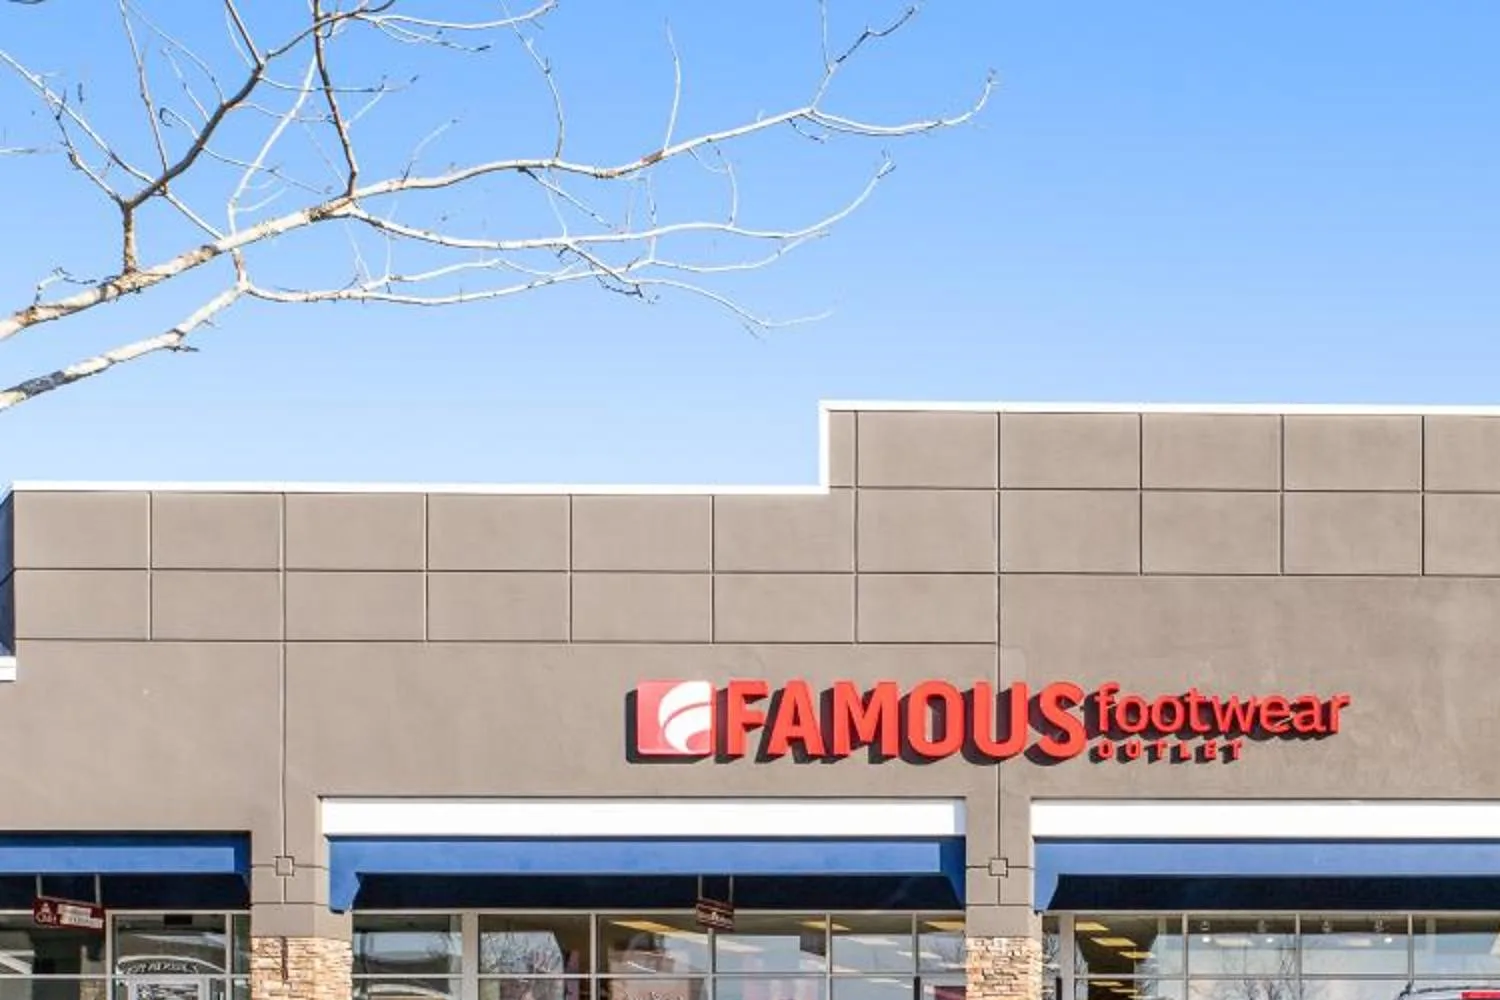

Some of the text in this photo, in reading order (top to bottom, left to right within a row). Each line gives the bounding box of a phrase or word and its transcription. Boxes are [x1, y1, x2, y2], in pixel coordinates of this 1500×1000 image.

[727, 680, 1351, 758] FAMOUS footwear
[1099, 739, 1242, 760] OUTLET
